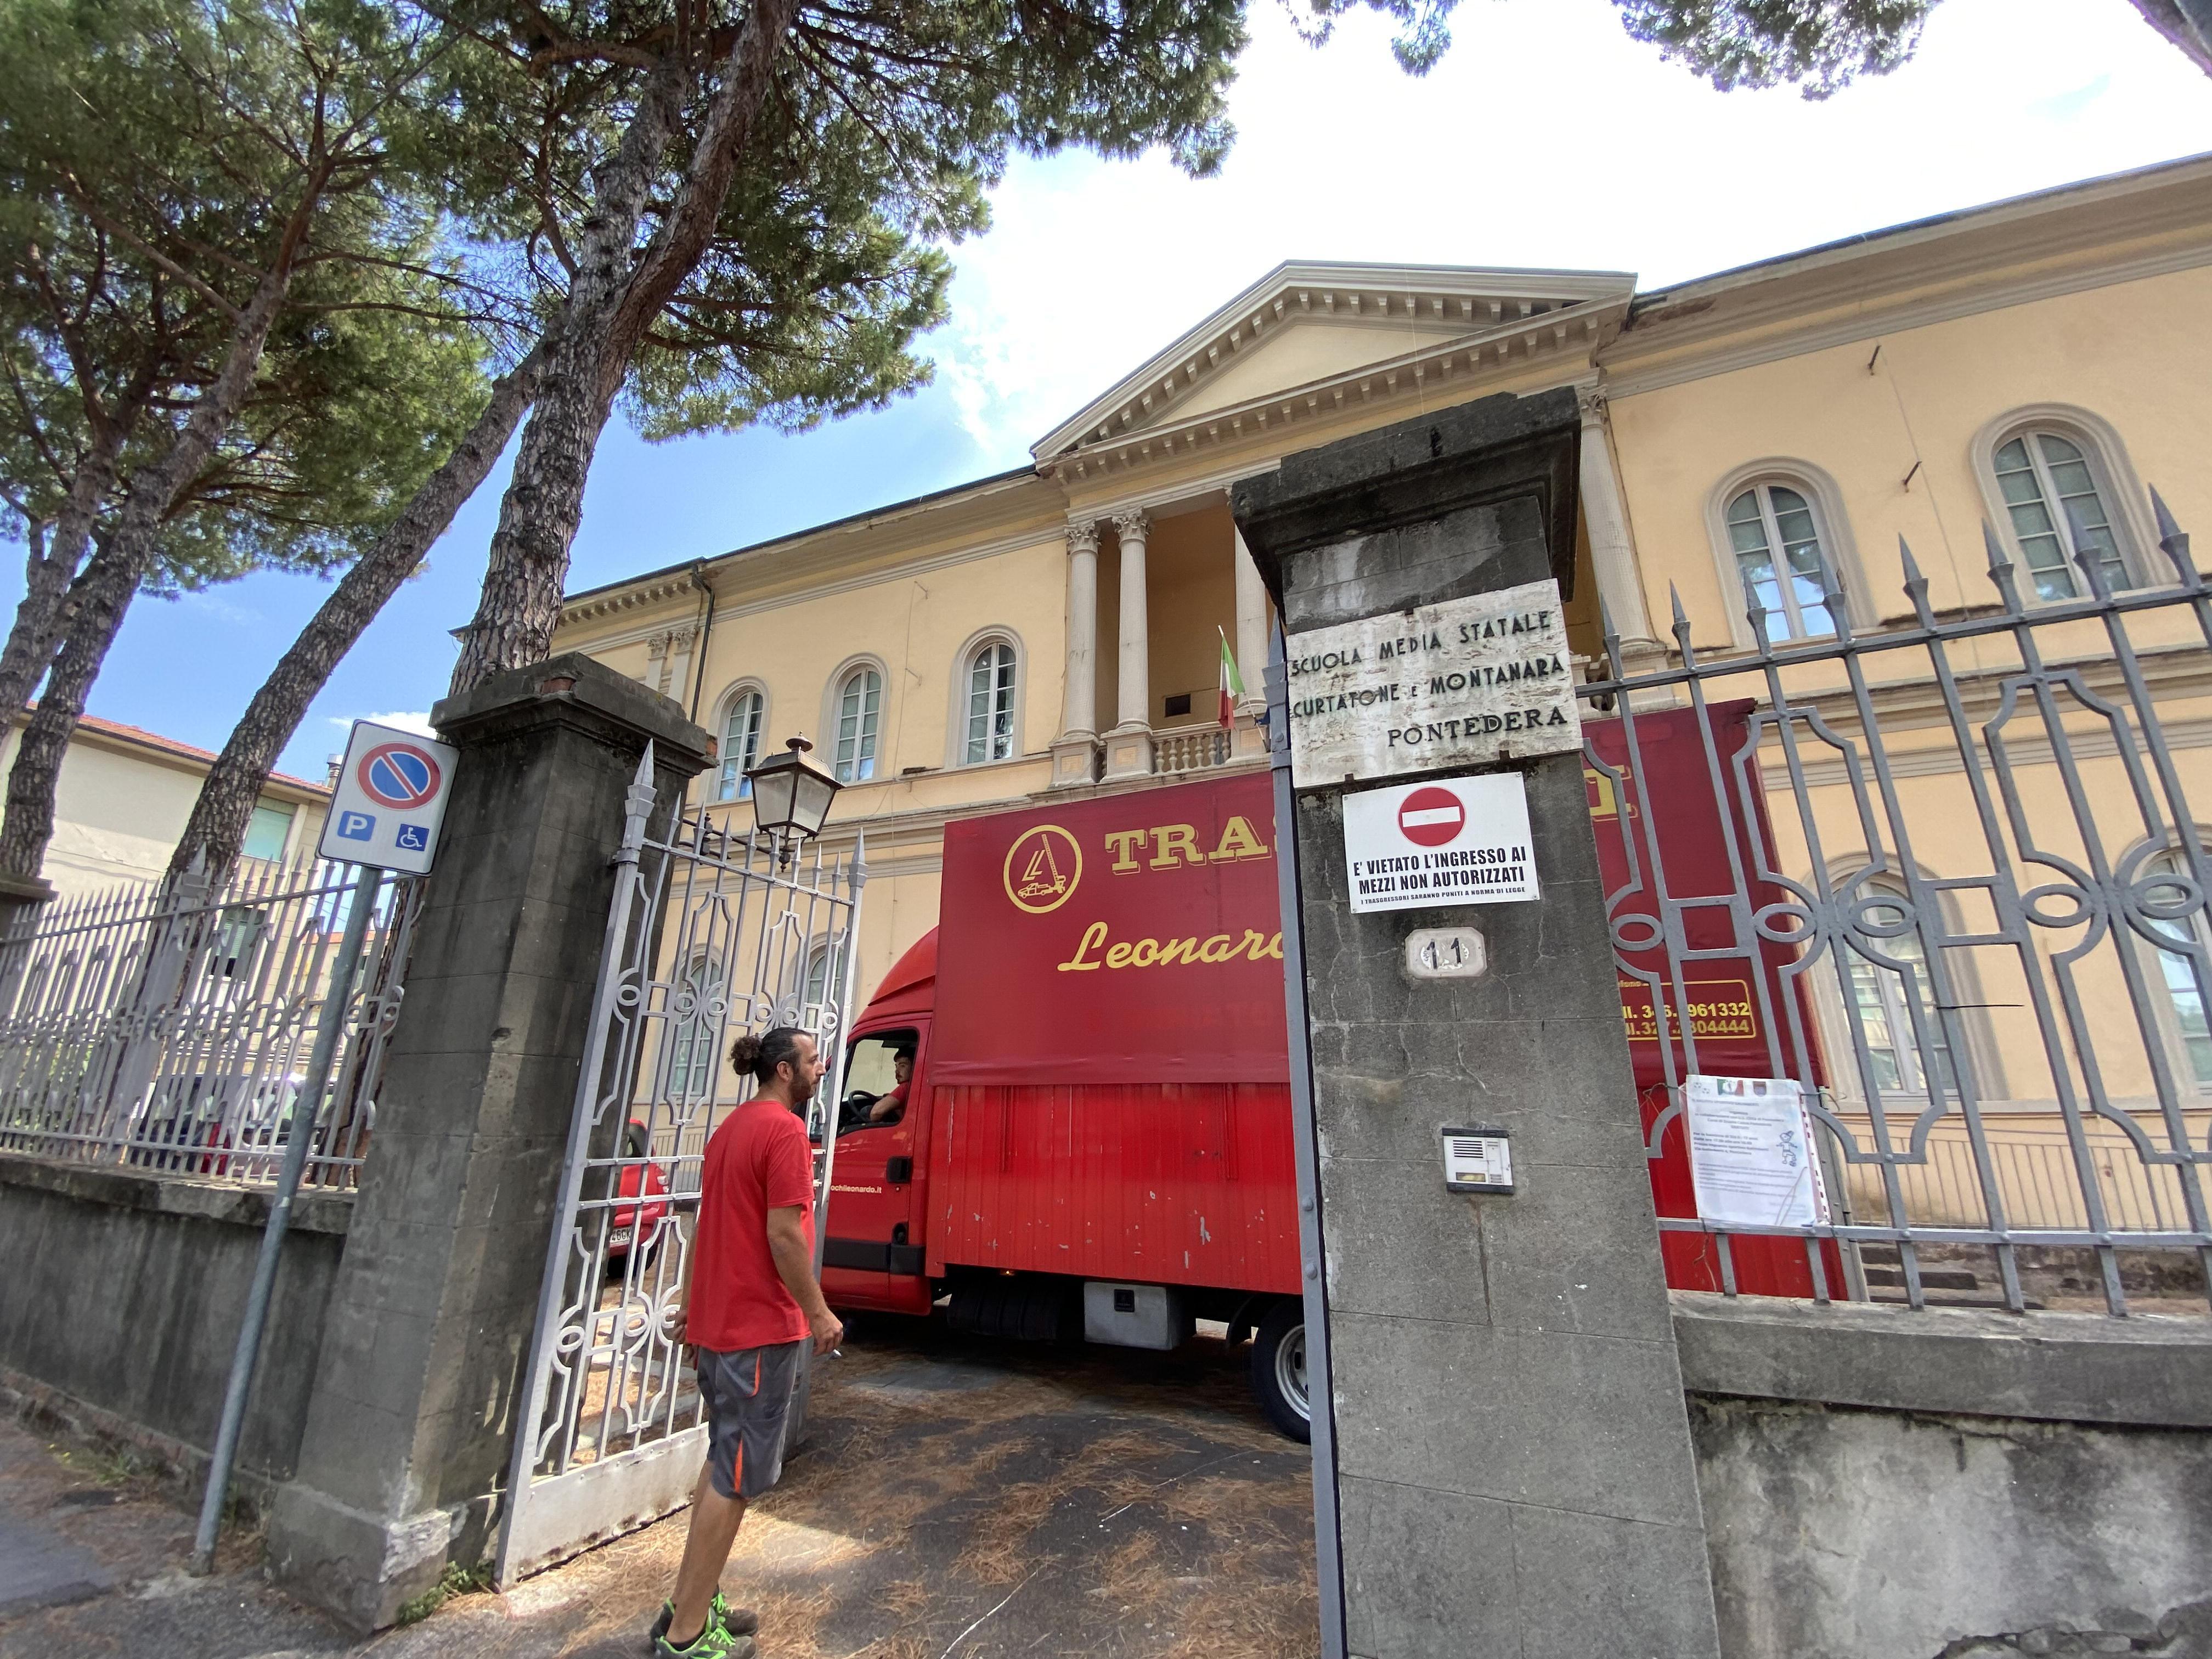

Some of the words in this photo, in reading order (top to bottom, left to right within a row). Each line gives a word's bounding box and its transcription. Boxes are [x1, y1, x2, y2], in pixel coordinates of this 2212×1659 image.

[1291, 648, 1362, 676] SCUOLA
[1379, 631, 1441, 659] MEDIA
[1460, 611, 1550, 643] STATALE
[1293, 684, 1400, 718] CURTATONE
[1411, 685, 1418, 697] E
[1430, 656, 1564, 695] MONTANARA
[1388, 706, 1567, 747] PONTEDERA
[345, 815, 368, 836] P
[1105, 816, 1278, 876] TRA
[1367, 855, 1419, 874] VIETATO
[1424, 848, 1506, 868] L'INGRESSO
[1511, 847, 1526, 862] AI
[1359, 877, 1395, 894] MEZZI
[1400, 873, 1428, 890] NON
[1433, 866, 1525, 887] AUTORIZZATI
[1365, 896, 1409, 904] TRASGRESSORI
[1426, 938, 1462, 970] 11
[830, 1184, 882, 1193] ochileonardo.it
